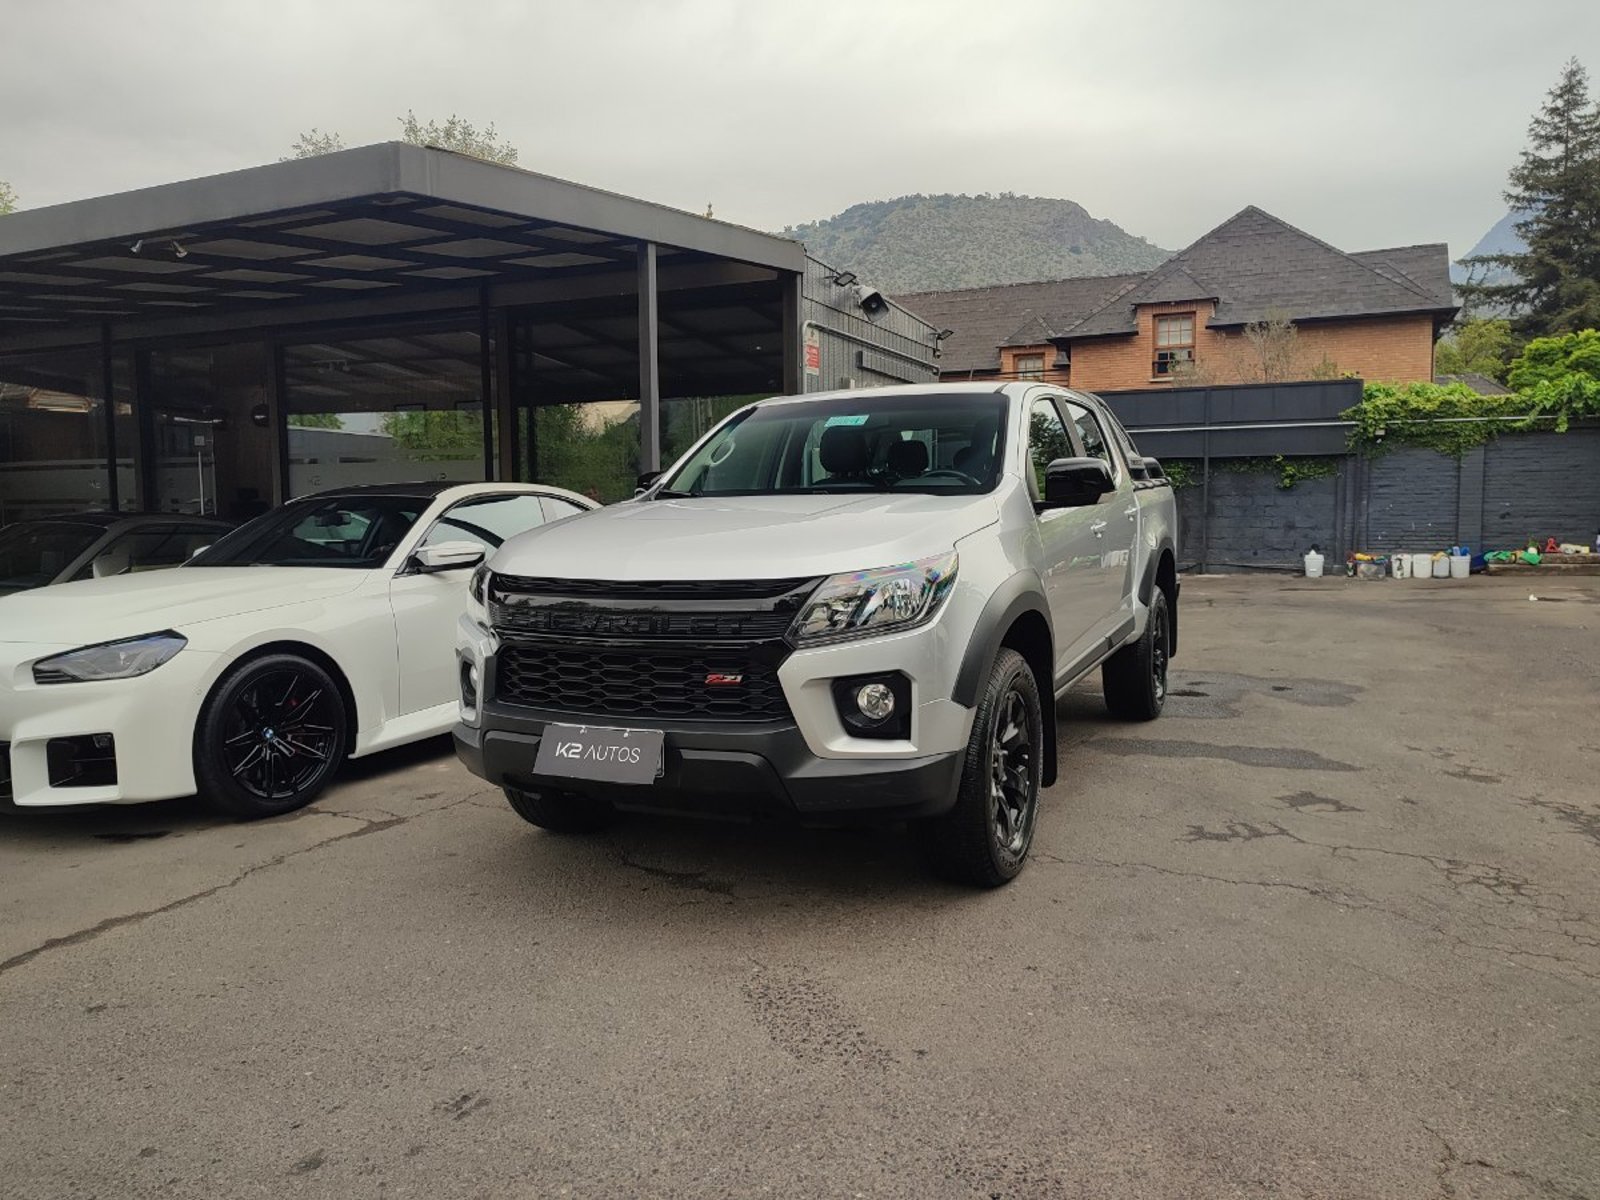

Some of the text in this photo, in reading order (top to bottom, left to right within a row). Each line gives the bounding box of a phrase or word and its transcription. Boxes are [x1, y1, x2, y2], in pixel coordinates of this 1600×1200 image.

[704, 673, 743, 684] Z71
[555, 742, 641, 764] K2 AUTOS
